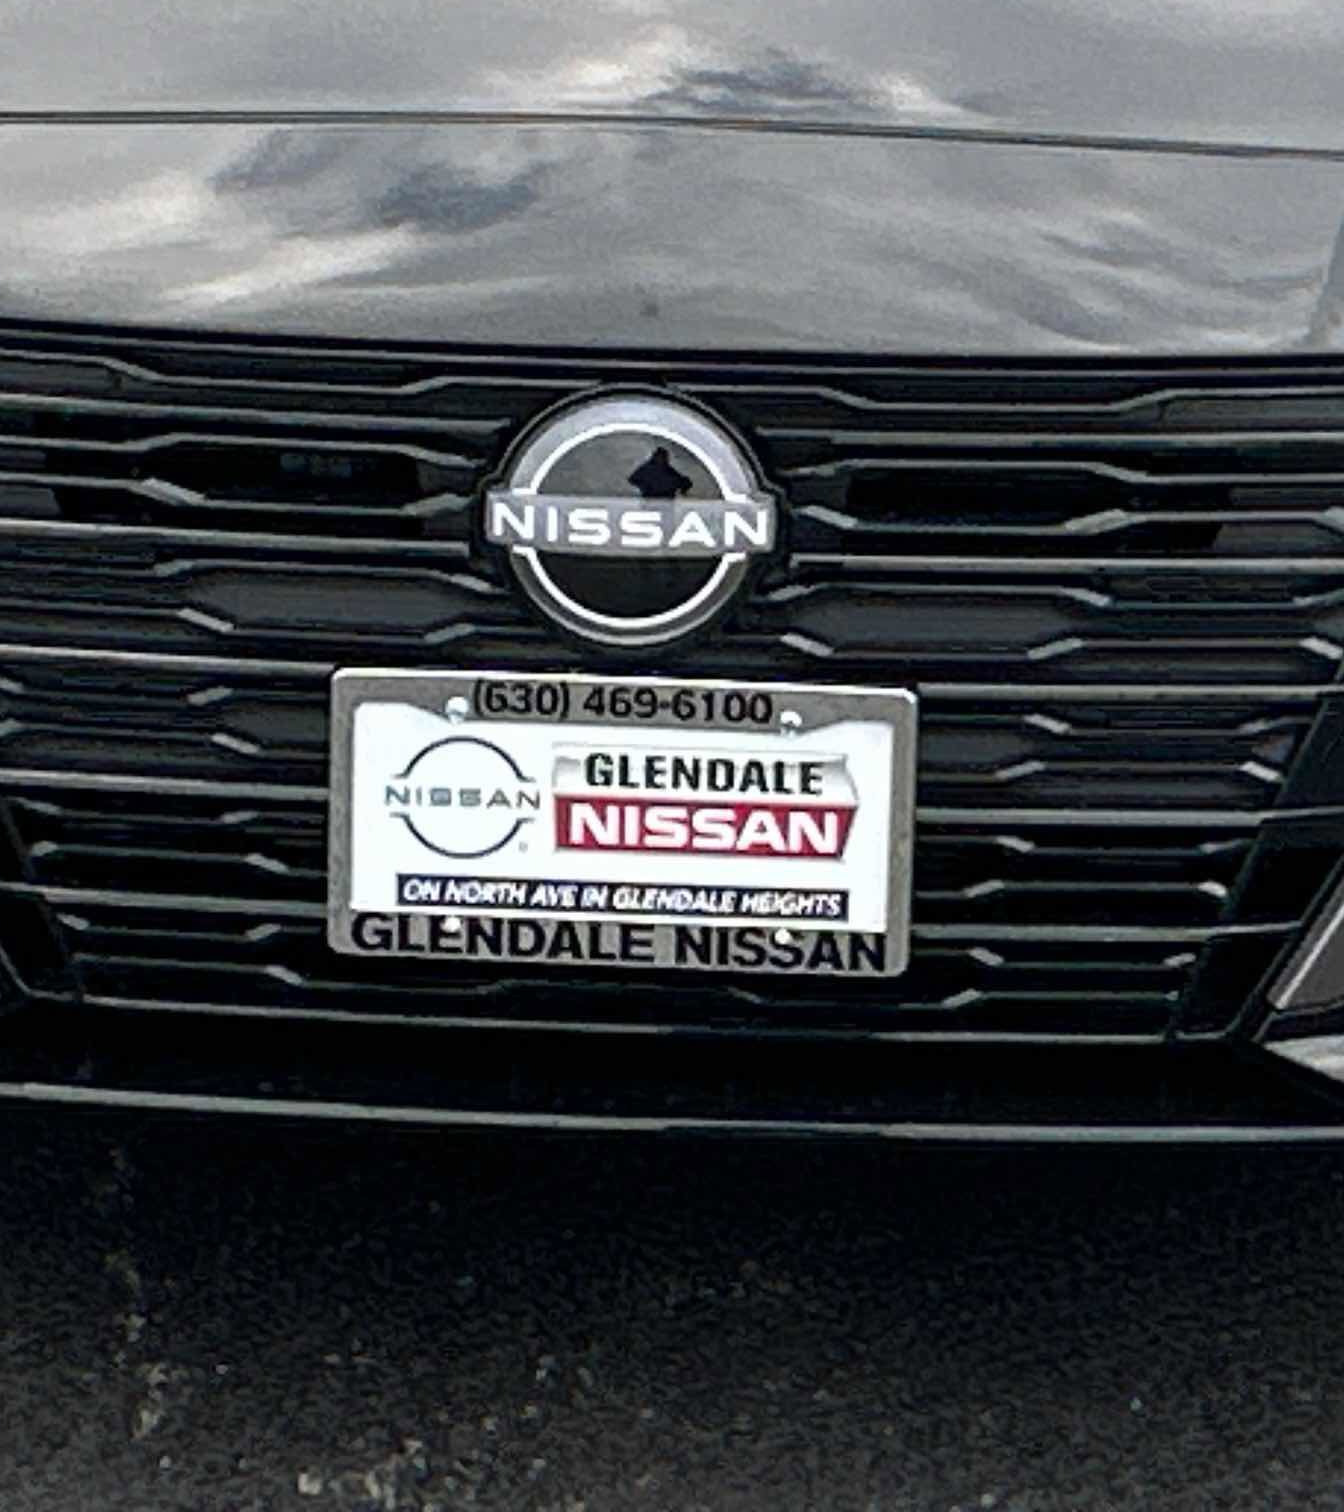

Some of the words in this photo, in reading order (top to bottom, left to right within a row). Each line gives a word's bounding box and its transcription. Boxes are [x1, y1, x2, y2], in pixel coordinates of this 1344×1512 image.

[492, 502, 768, 550] NISSAN
[472, 678, 570, 719] (630)
[583, 685, 774, 724] 469-6100
[585, 752, 825, 796] GLENDALE
[384, 785, 541, 810] NISSAN
[569, 802, 838, 855] NISSAN
[404, 878, 441, 902] ON
[444, 880, 528, 906] NORTH
[530, 884, 578, 908] AVE
[580, 885, 608, 908] IN
[612, 885, 737, 914] GLENDALE
[741, 890, 842, 917] HEIGHTS
[351, 911, 656, 962] GLENDALE
[674, 924, 887, 972] NISSAN
